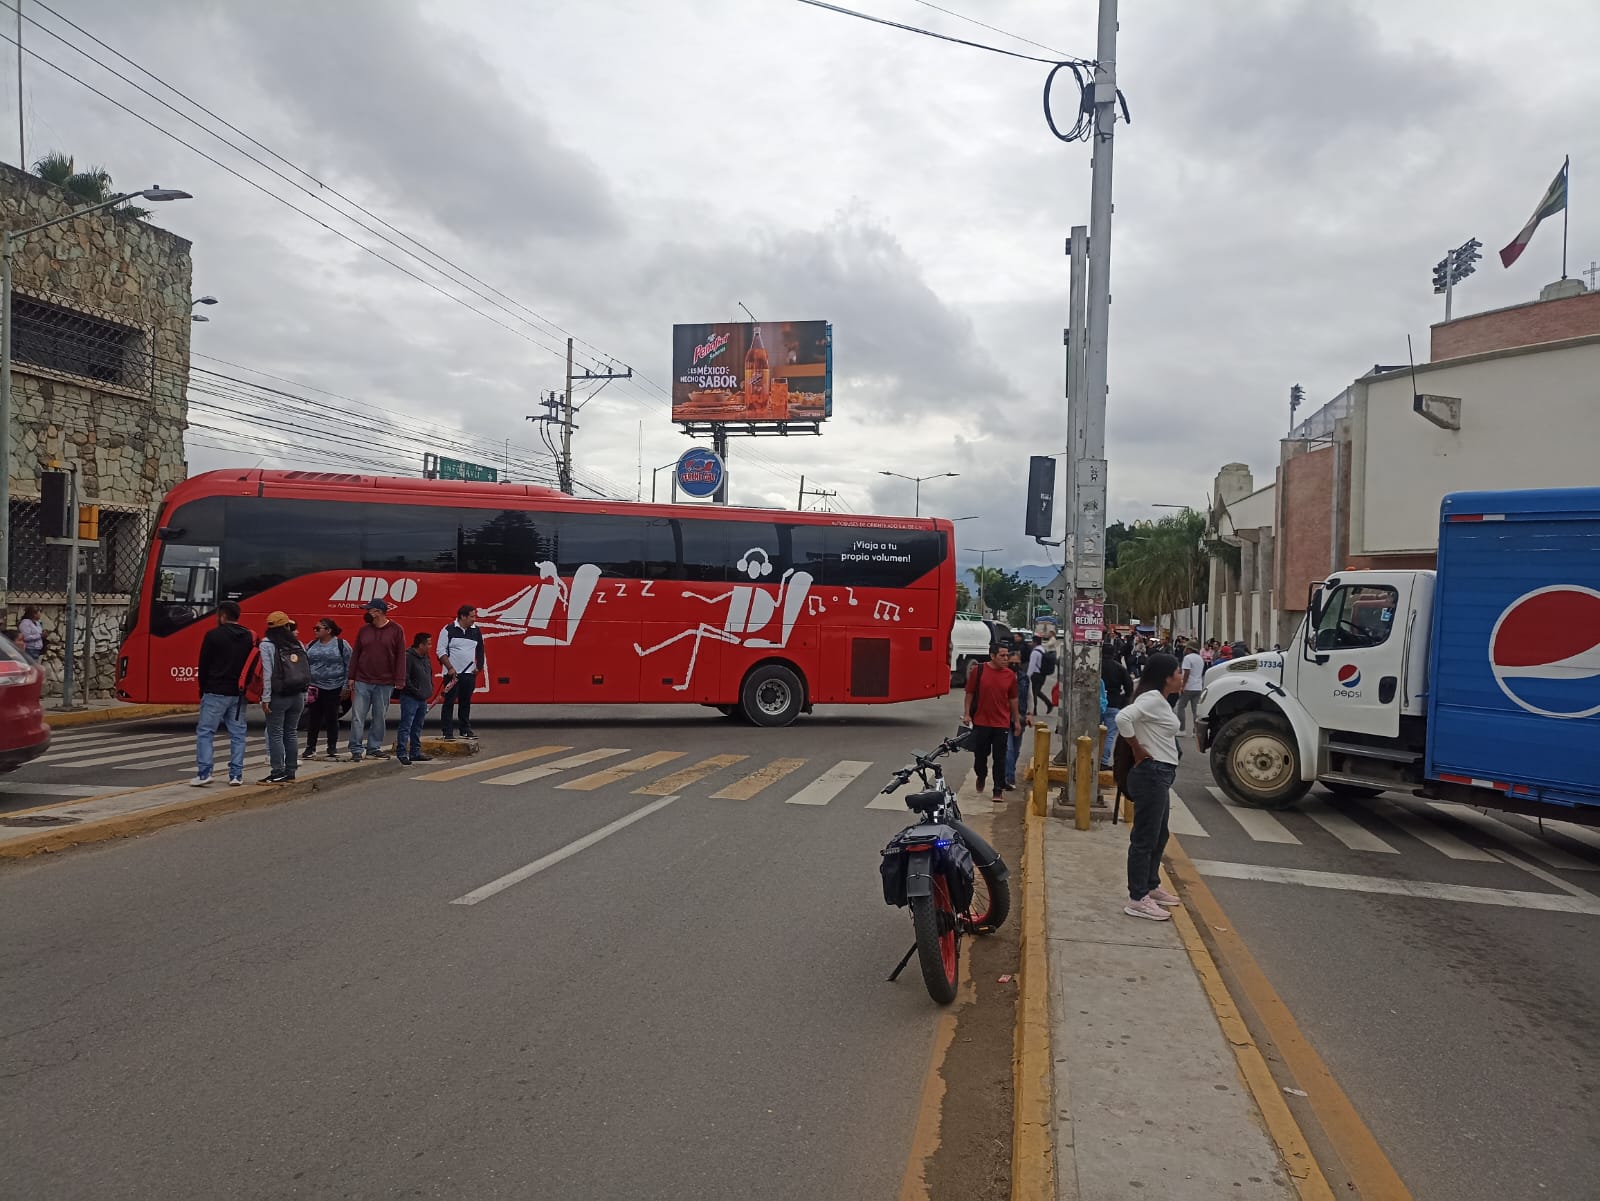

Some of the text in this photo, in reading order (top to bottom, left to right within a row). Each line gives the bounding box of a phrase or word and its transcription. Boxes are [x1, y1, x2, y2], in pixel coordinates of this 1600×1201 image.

[697, 365, 726, 375] MÉXICO
[680, 375, 699, 383] HECHO
[699, 375, 738, 388] SABOR
[853, 541, 878, 551] ¡Viaja
[841, 553, 911, 563] propio volumen!
[329, 576, 418, 603] ADO
[1333, 689, 1362, 699] pepsi
